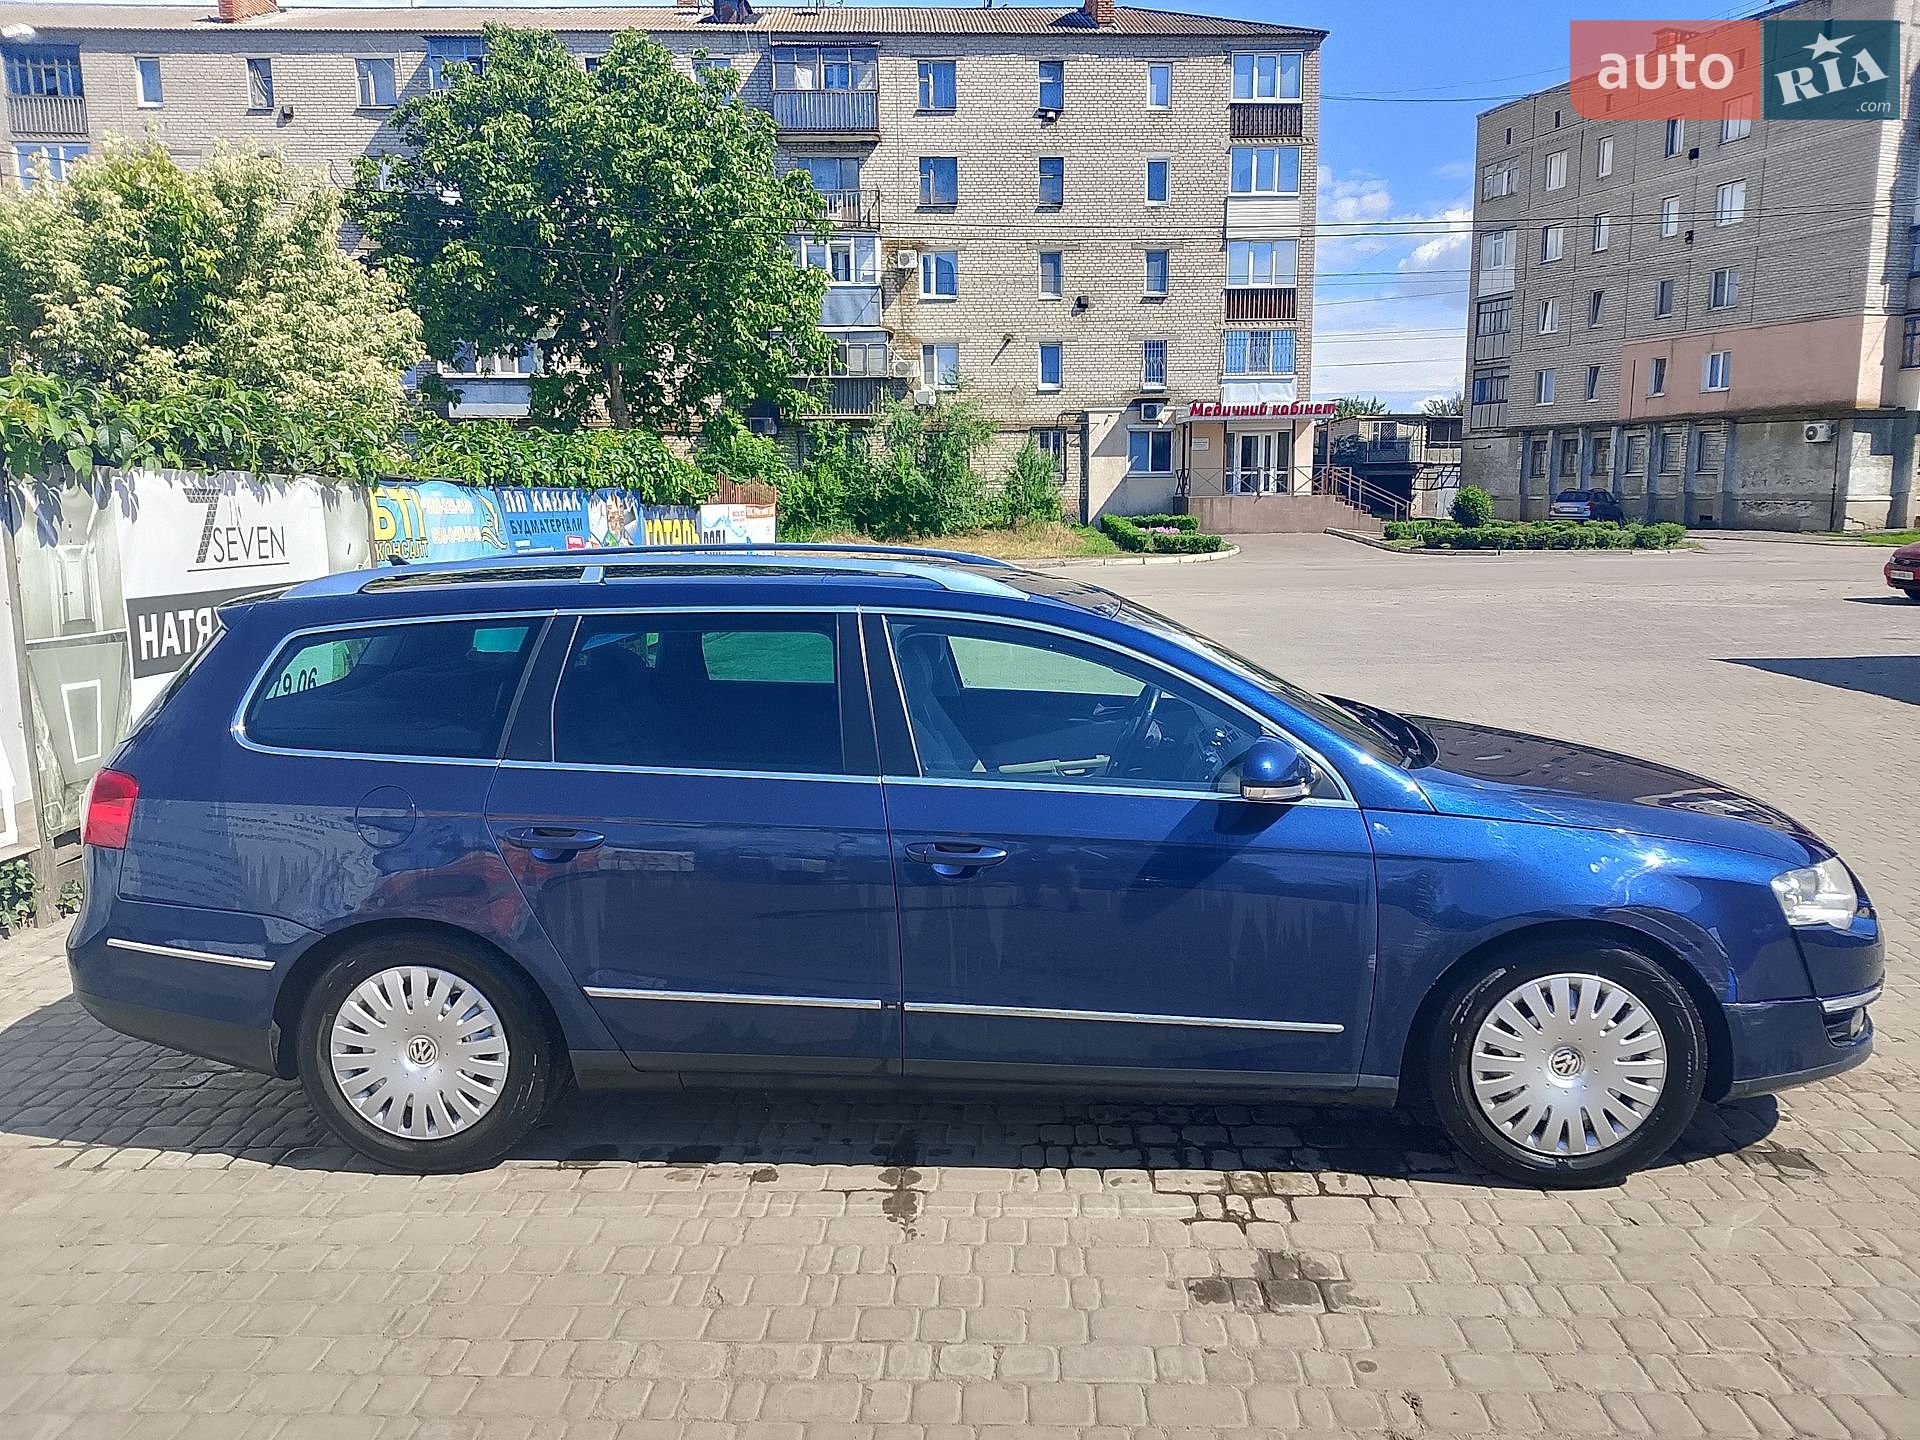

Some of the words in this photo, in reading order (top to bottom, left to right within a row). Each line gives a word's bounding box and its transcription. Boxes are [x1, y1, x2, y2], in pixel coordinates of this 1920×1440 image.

[1189, 402, 1269, 417] Медичний
[1272, 401, 1337, 416] кабінет
[183, 488, 221, 563] 7
[212, 526, 286, 563] SEVEN
[138, 606, 216, 662] НАТЯ
